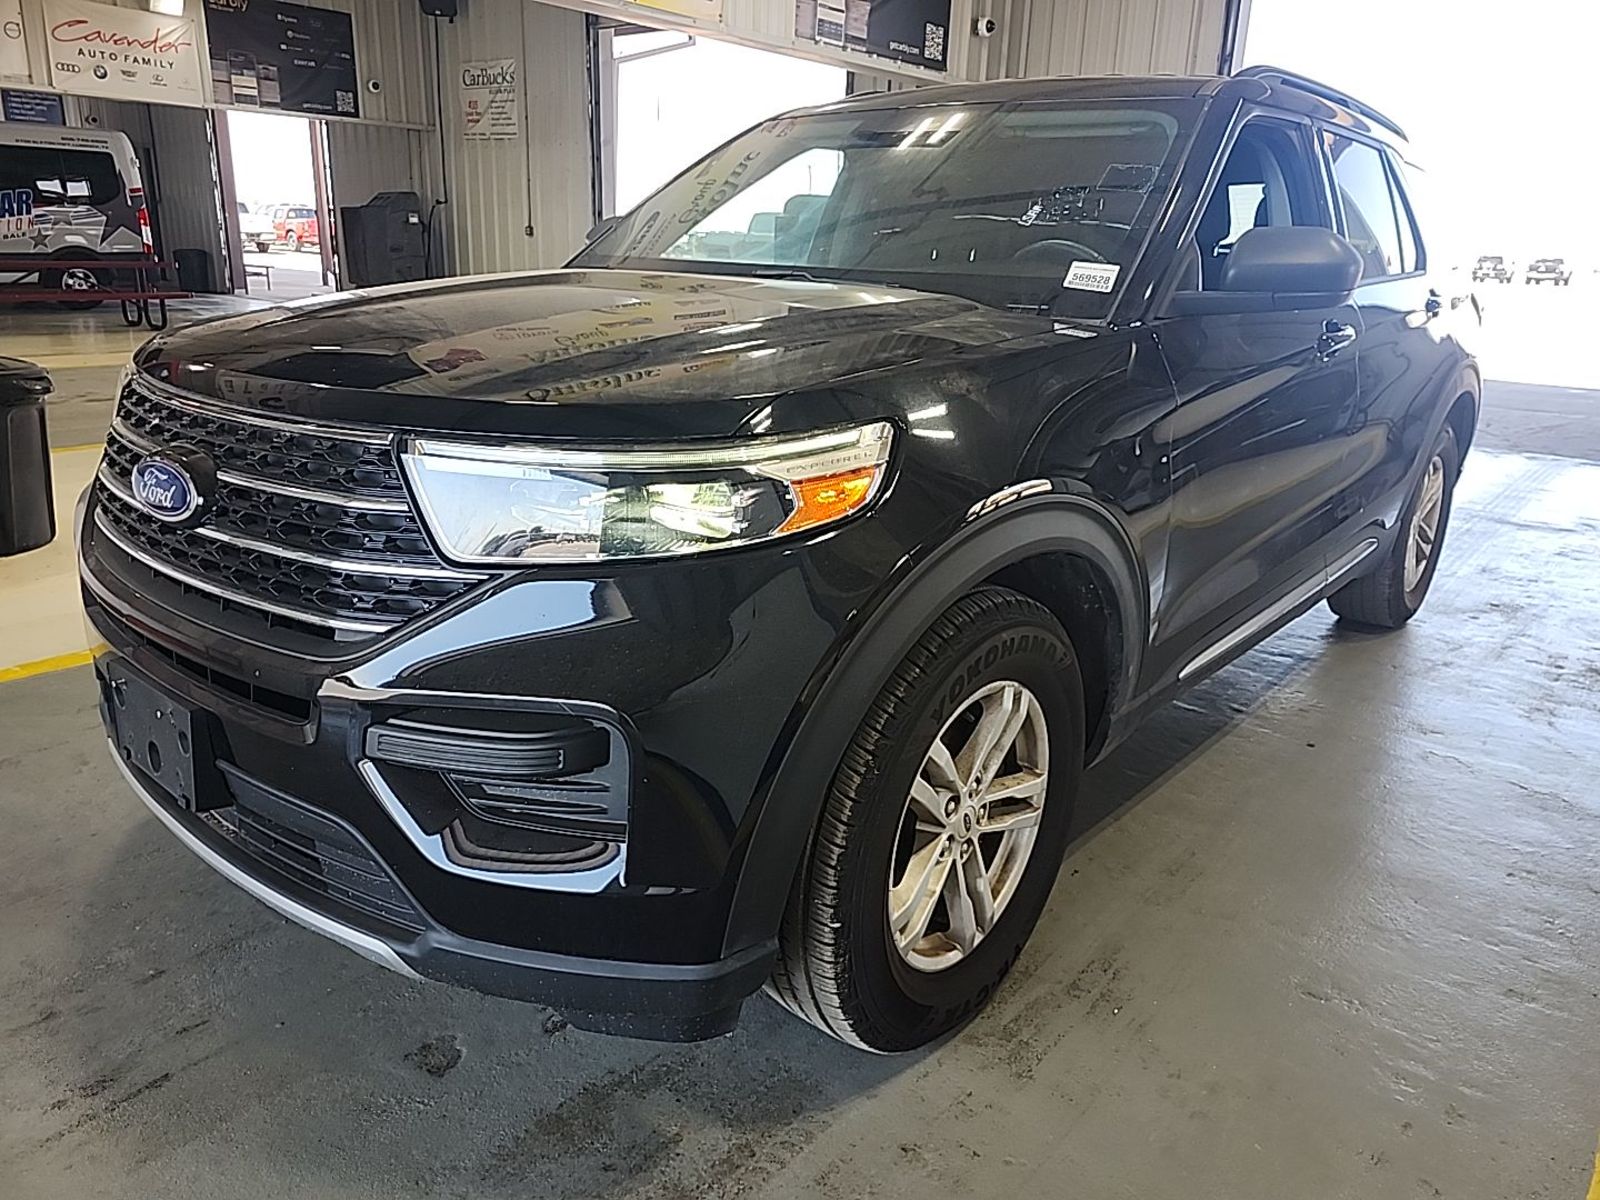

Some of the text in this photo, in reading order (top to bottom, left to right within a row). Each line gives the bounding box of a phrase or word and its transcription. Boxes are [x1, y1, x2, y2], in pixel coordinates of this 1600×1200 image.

[51, 19, 192, 54] Cavender
[77, 47, 175, 70] AUTO FAMILY
[462, 66, 516, 87] CarBucks
[0, 189, 33, 218] AR
[2, 231, 27, 240] SALE
[1071, 272, 1111, 285] 569528
[140, 467, 176, 508] Ford
[930, 633, 1058, 726] YOKOHAMA
